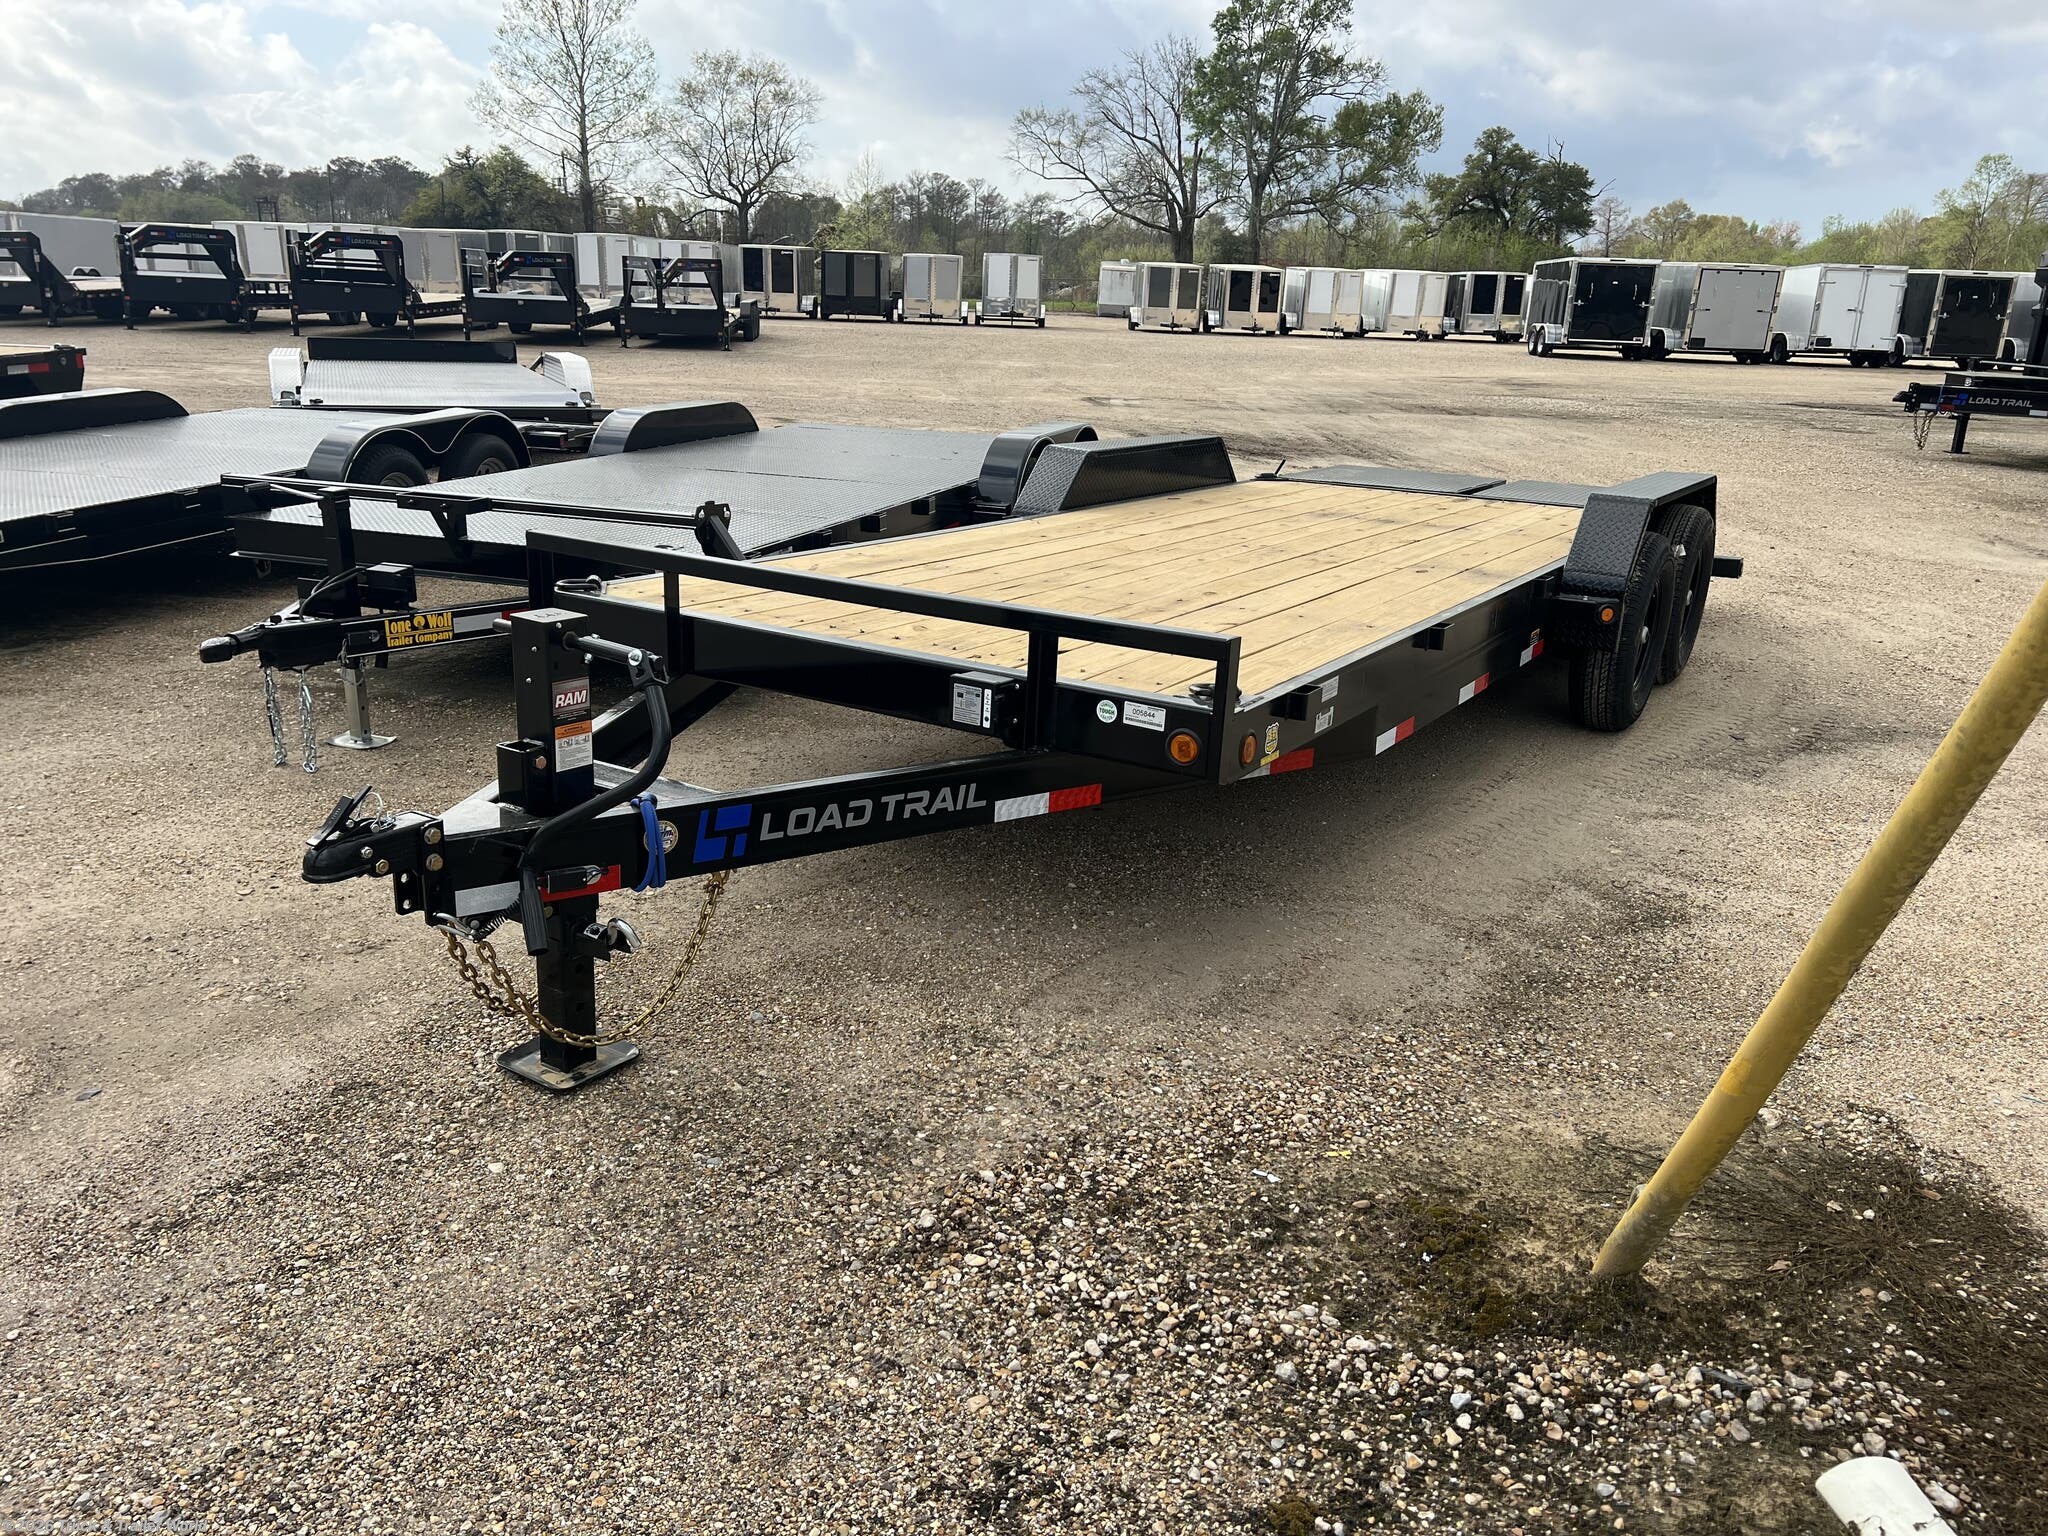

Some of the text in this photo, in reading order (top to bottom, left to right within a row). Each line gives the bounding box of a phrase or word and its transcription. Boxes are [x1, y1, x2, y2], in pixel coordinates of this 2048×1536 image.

[1968, 396, 2033, 408] LOAD TRAIL
[384, 611, 452, 636] Lone Wolf
[386, 631, 453, 647] Trailer Company
[555, 689, 587, 709] RAM
[759, 798, 873, 841] LOAD
[881, 783, 987, 822] TRAIL
